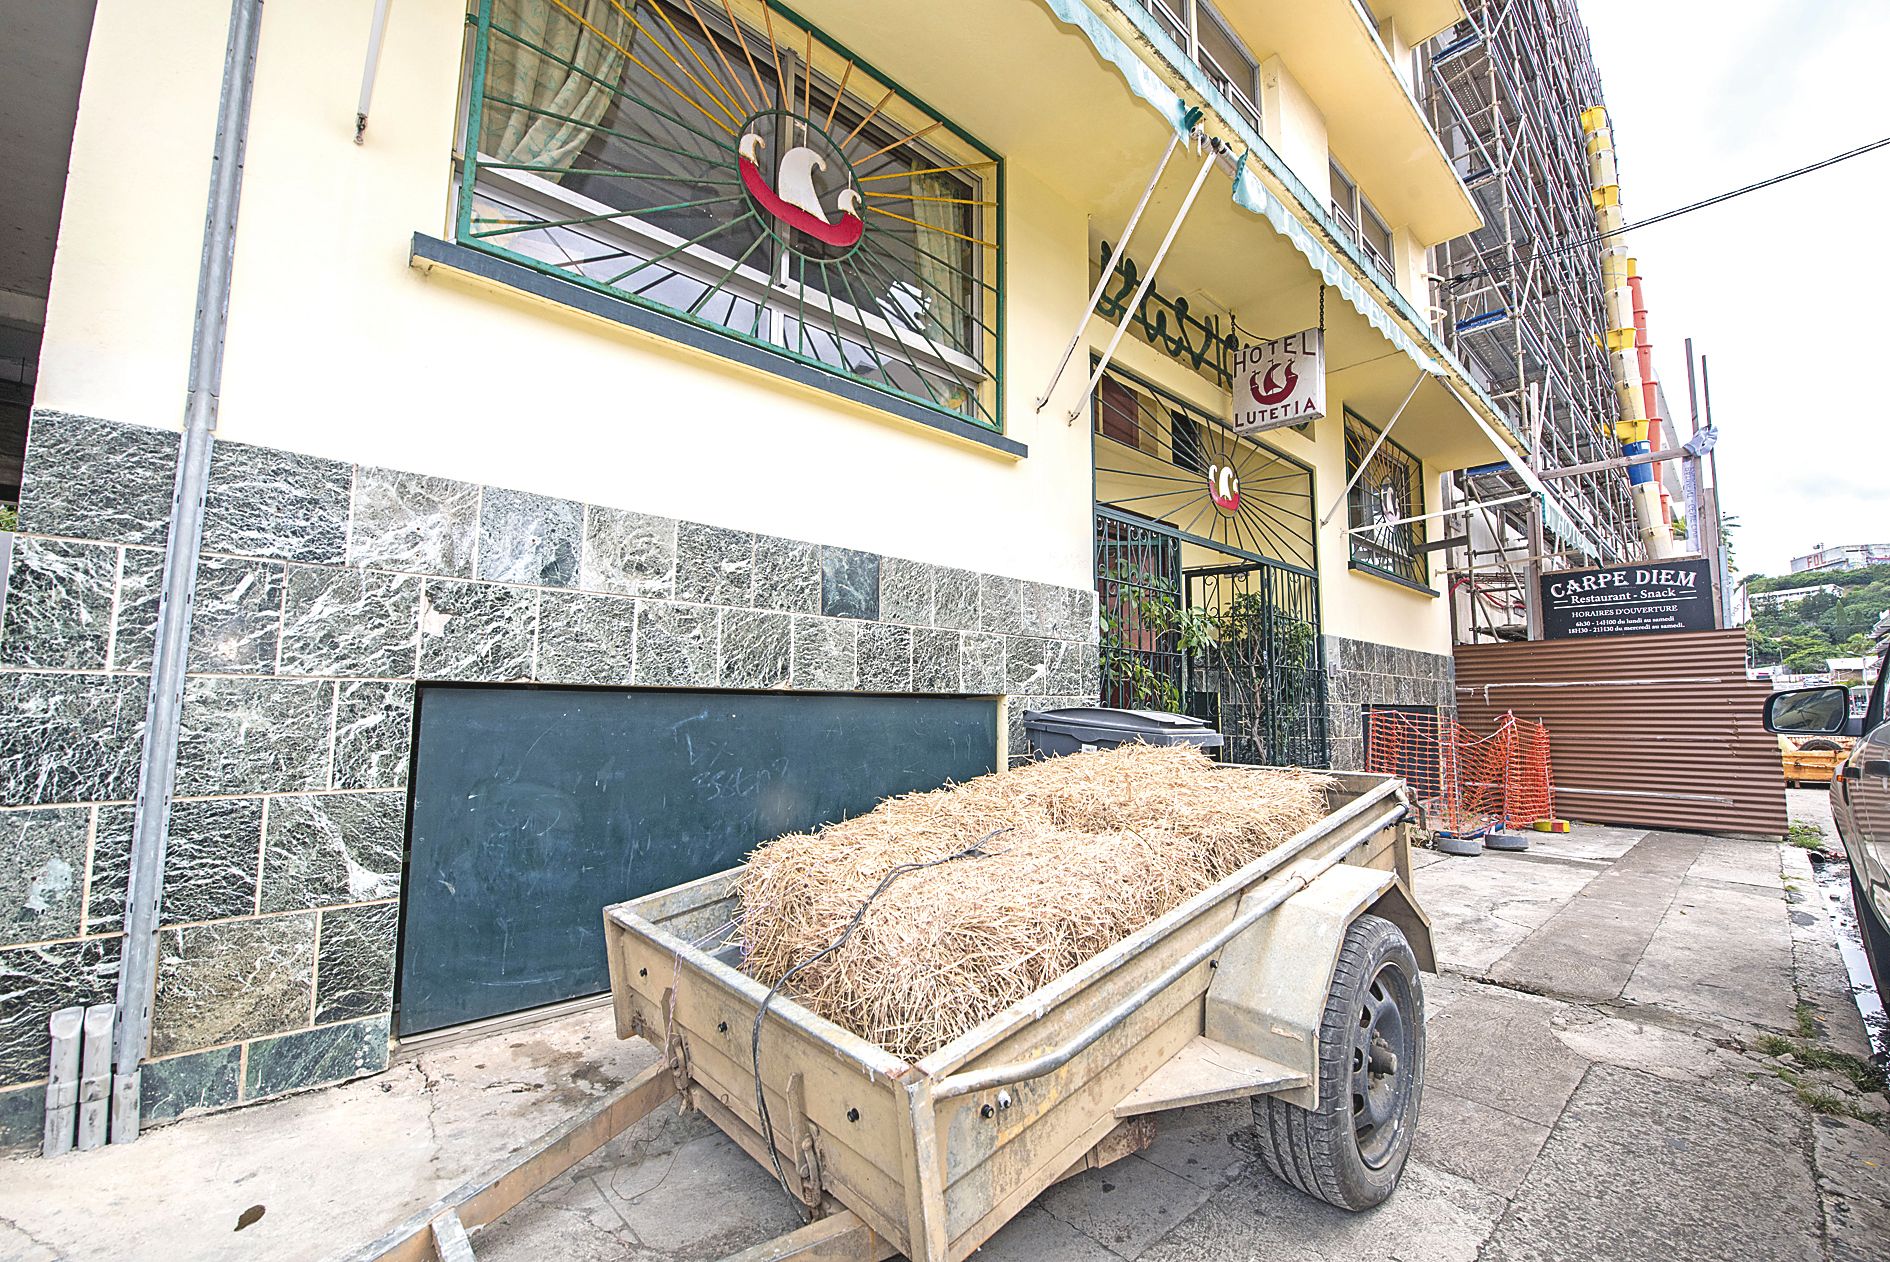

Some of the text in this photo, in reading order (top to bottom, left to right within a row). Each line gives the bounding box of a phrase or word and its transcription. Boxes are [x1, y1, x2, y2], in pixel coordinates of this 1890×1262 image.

[1233, 332, 1316, 378] HOTEL
[1234, 397, 1316, 428] LUTETIA
[1806, 552, 1827, 568] FOL
[1550, 569, 1697, 597] CARPE DIEM
[1571, 592, 1631, 604] Restaurant
[1640, 588, 1676, 599] Snack
[1571, 605, 1678, 618] HORAIRES D'OUVERTURE
[1652, 615, 1675, 623] samedi
